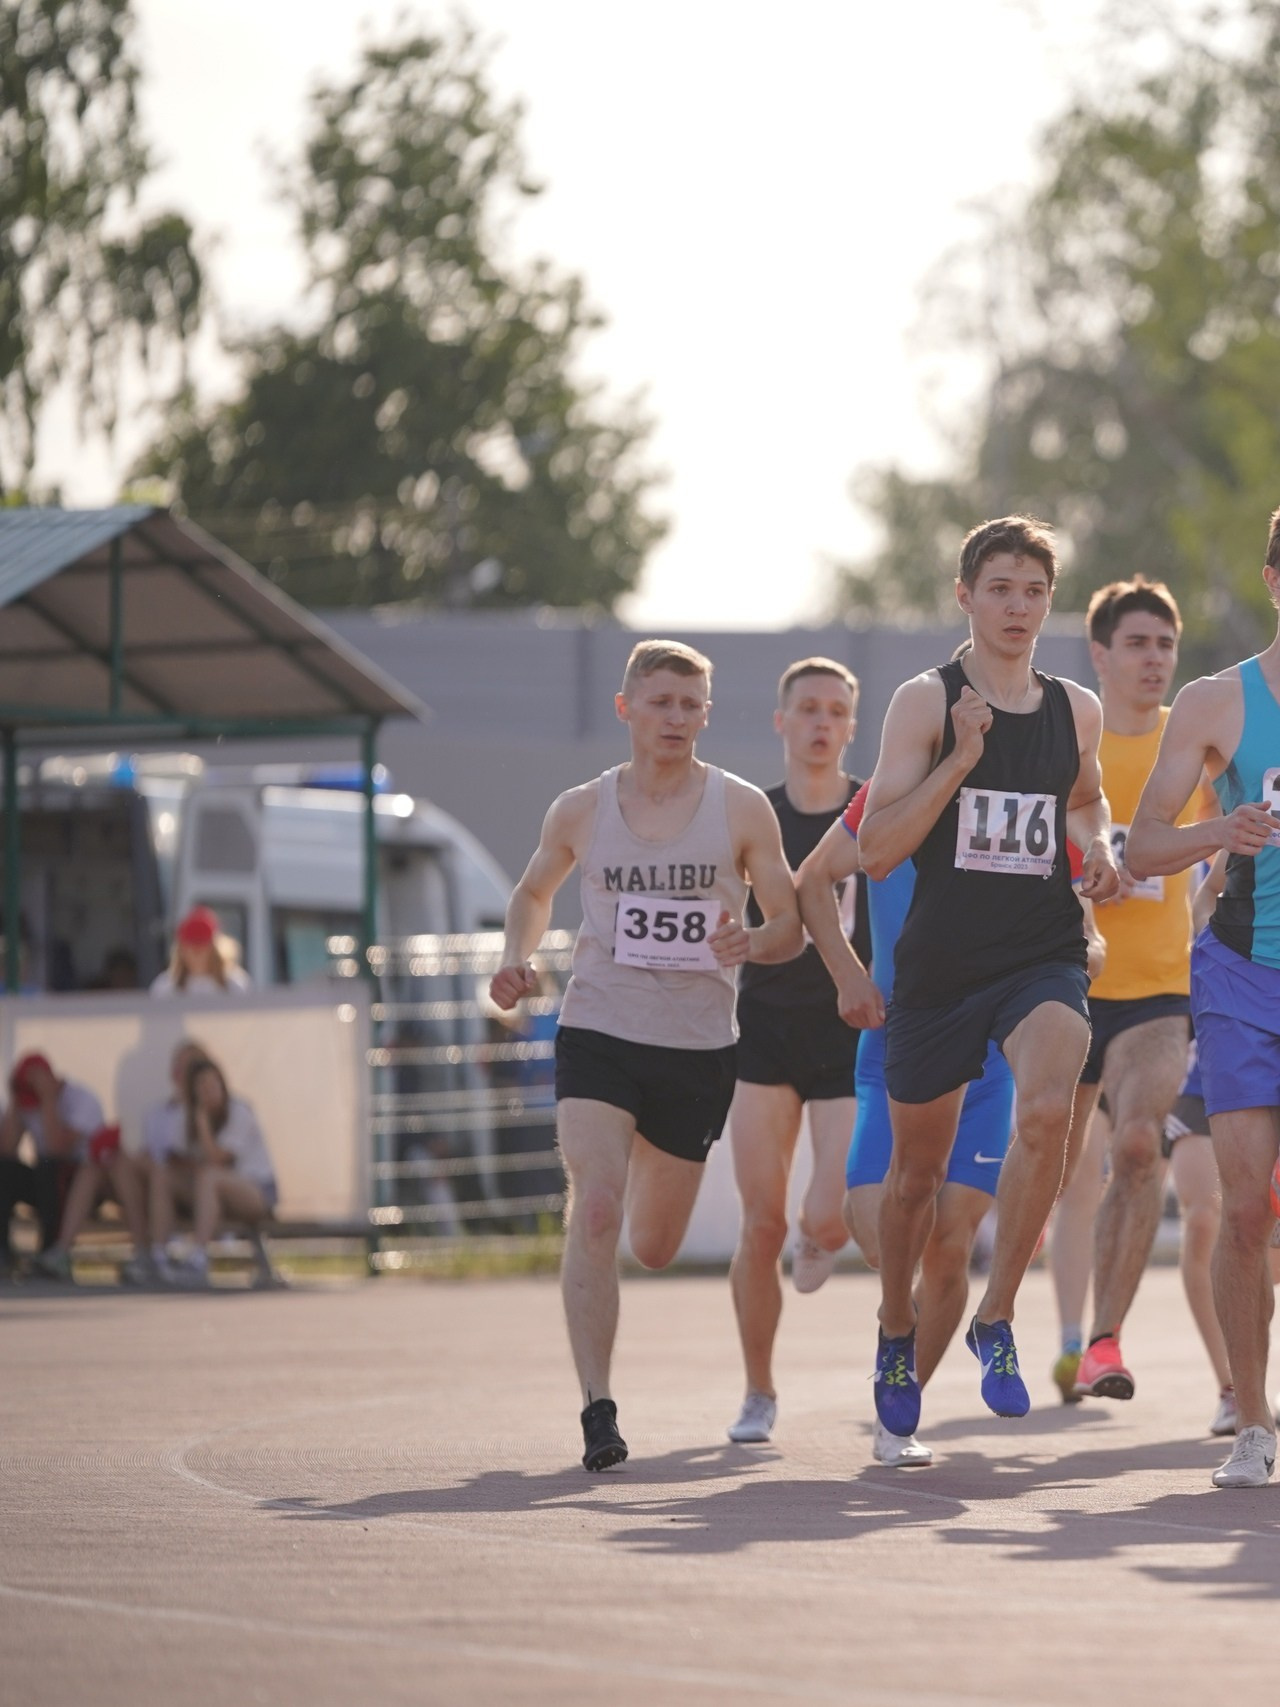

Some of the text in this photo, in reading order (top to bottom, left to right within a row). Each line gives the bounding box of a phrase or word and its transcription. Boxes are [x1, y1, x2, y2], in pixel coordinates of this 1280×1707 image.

[969, 795, 1050, 857] 116
[962, 851, 978, 860] ЦФО
[979, 853, 990, 861] ПО
[992, 855, 1020, 863] ЛЕГКОЙ
[603, 864, 717, 892] MALIBU
[623, 907, 706, 944] 358
